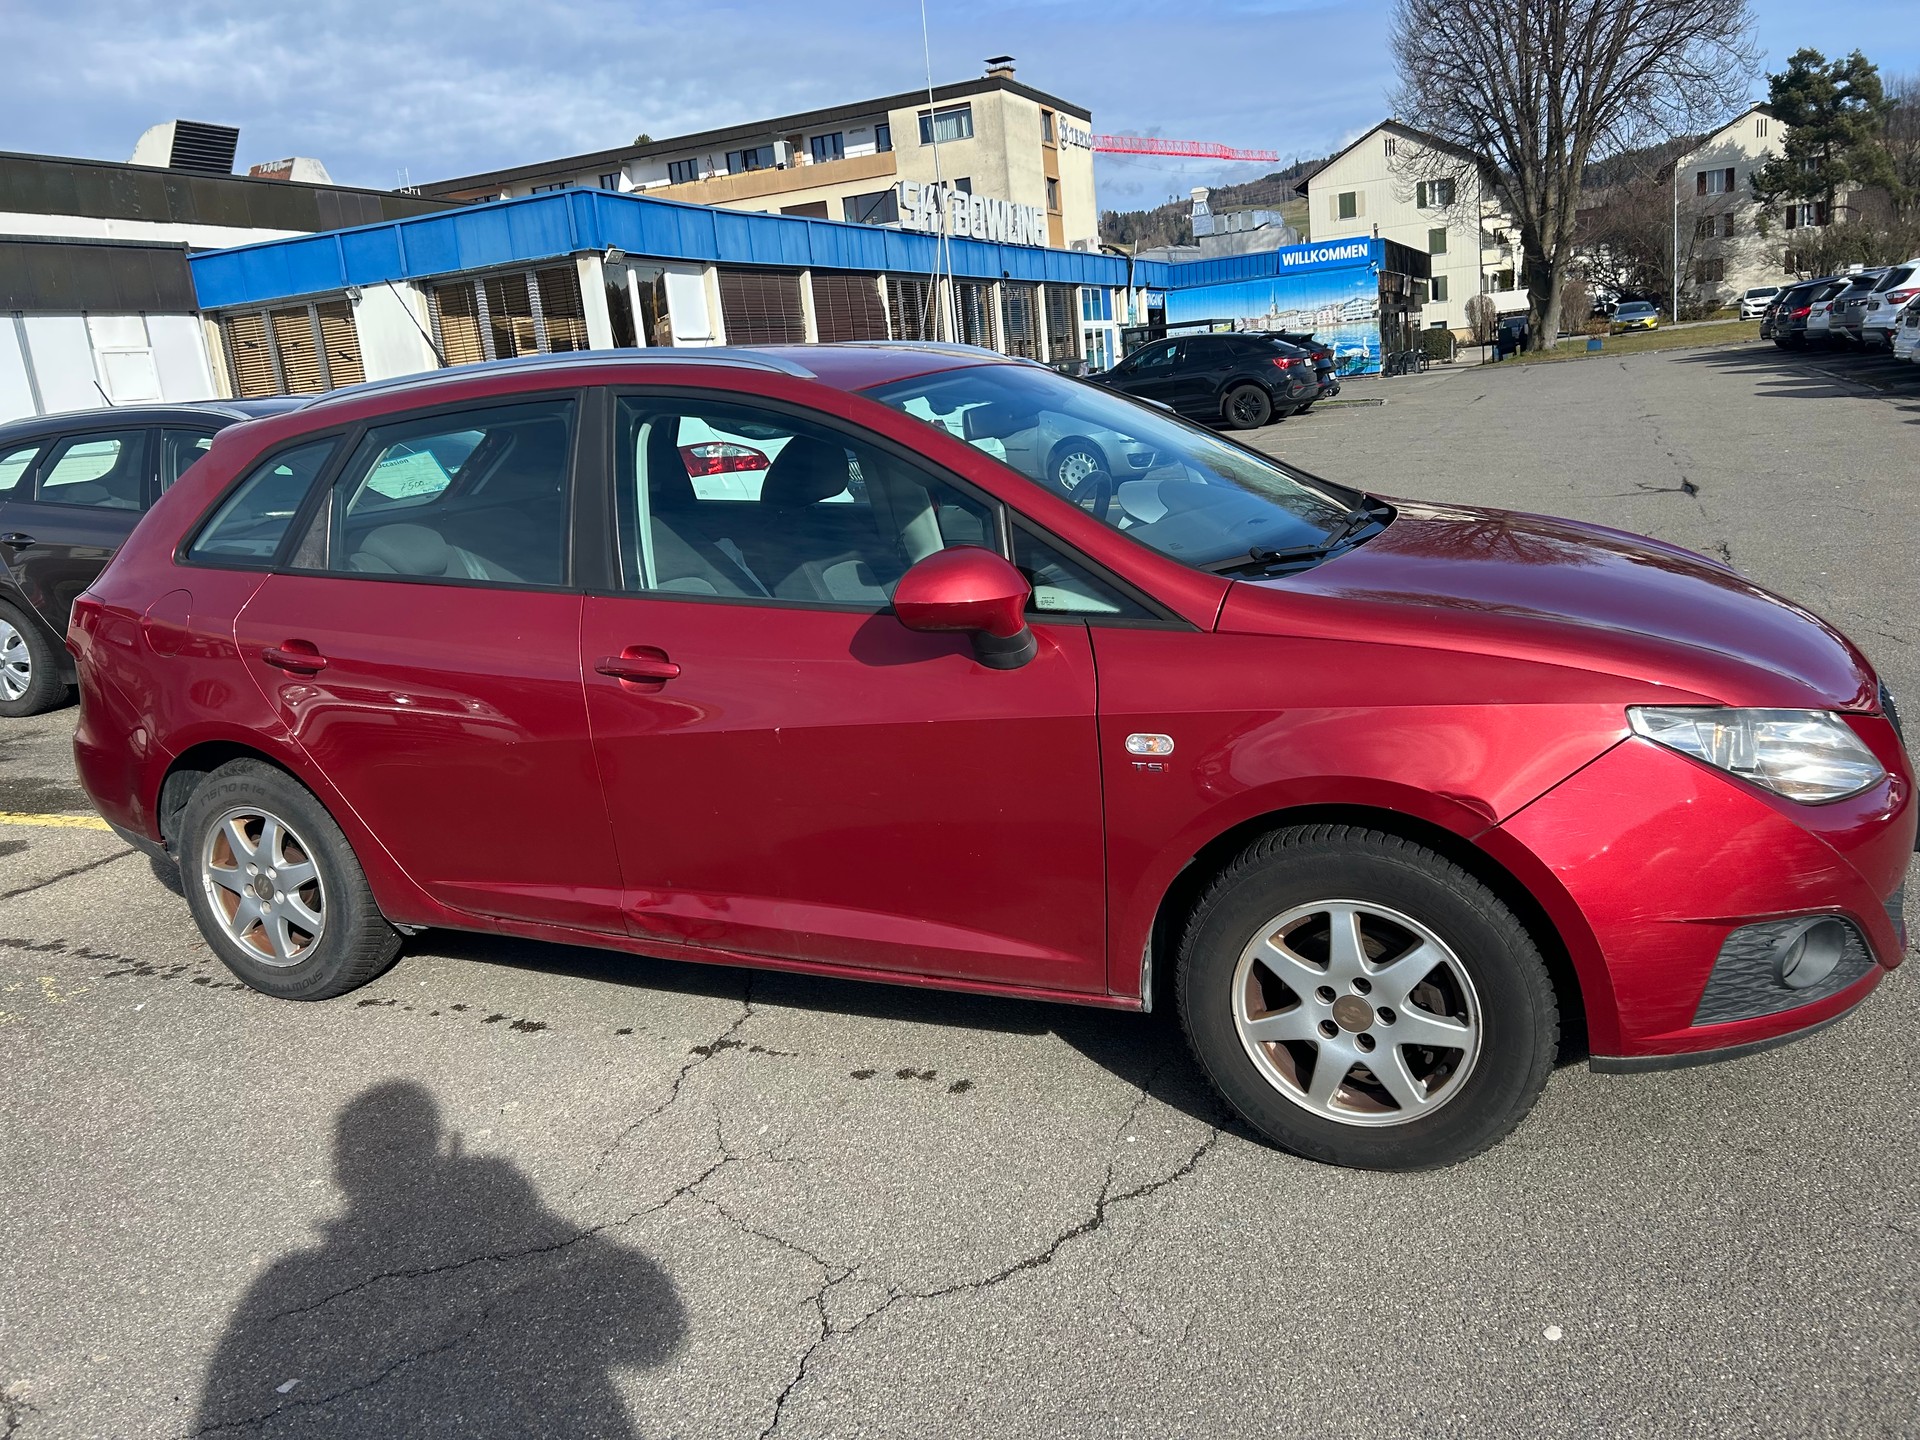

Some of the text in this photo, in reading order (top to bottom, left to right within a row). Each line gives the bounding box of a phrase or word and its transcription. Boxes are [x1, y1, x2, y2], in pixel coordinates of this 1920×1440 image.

[901, 179, 1046, 247] SKY BOWLING
[1282, 244, 1368, 267] WILLKOMMEN
[1131, 761, 1169, 773] TSI
